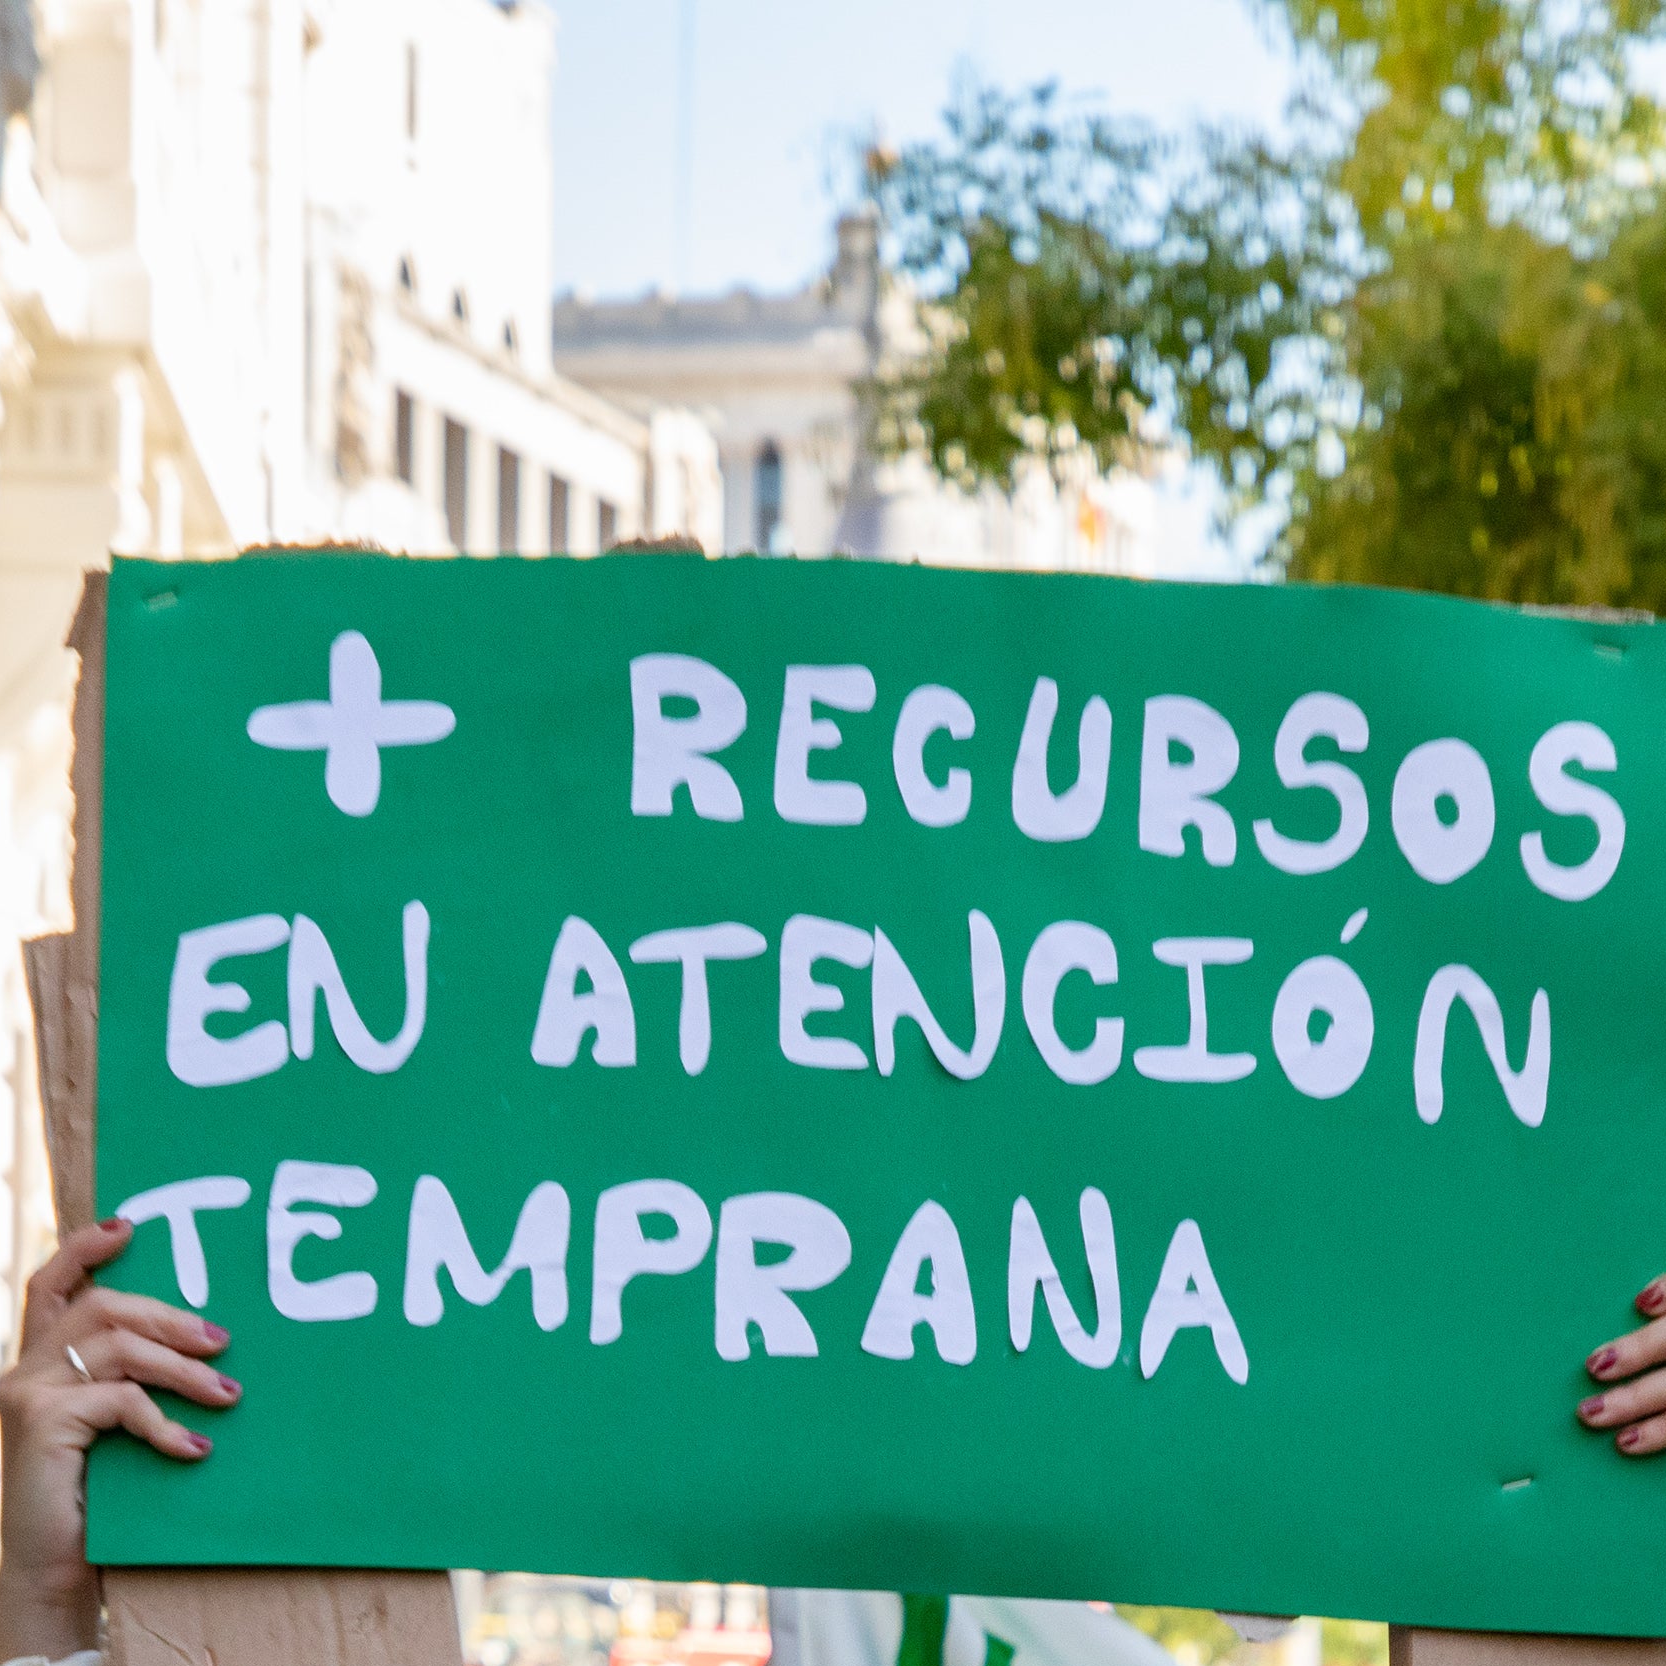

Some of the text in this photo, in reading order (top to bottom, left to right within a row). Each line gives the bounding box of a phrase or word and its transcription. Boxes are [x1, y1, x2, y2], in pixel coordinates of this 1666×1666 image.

[247, 629, 1626, 904] + RECURSOS
[166, 899, 1551, 1127] EN ATENCIÓN
[119, 1158, 1250, 1385] TEMPRANA
